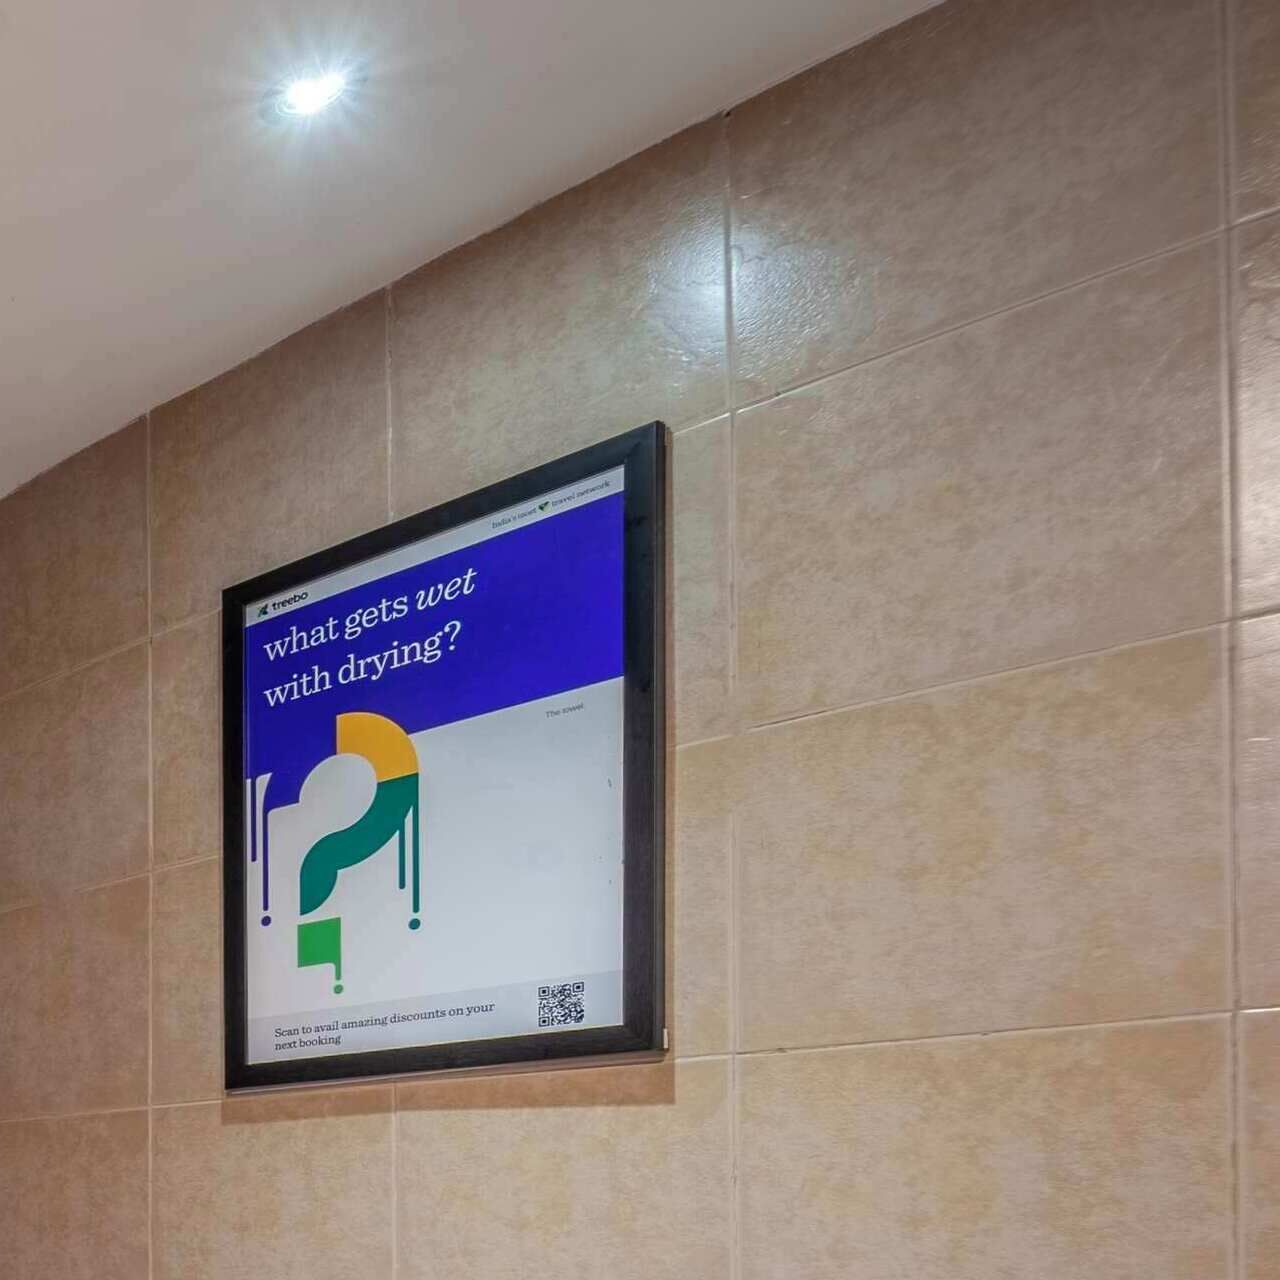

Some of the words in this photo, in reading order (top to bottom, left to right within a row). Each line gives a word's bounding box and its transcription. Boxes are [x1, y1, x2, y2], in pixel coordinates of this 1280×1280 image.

[263, 616, 340, 662] what
[344, 594, 409, 640] gets
[415, 567, 478, 611] wet
[272, 591, 309, 612] treebo
[263, 665, 333, 708] with
[337, 620, 462, 685] drying?
[274, 1027, 300, 1038] Scan
[301, 1025, 313, 1036] to
[314, 1020, 339, 1034] avail
[341, 1015, 388, 1031] amazing
[389, 1008, 447, 1024] discounts
[448, 1007, 464, 1017] on
[465, 1002, 496, 1017] your
[274, 1040, 297, 1051] next
[299, 1035, 342, 1048] booking
